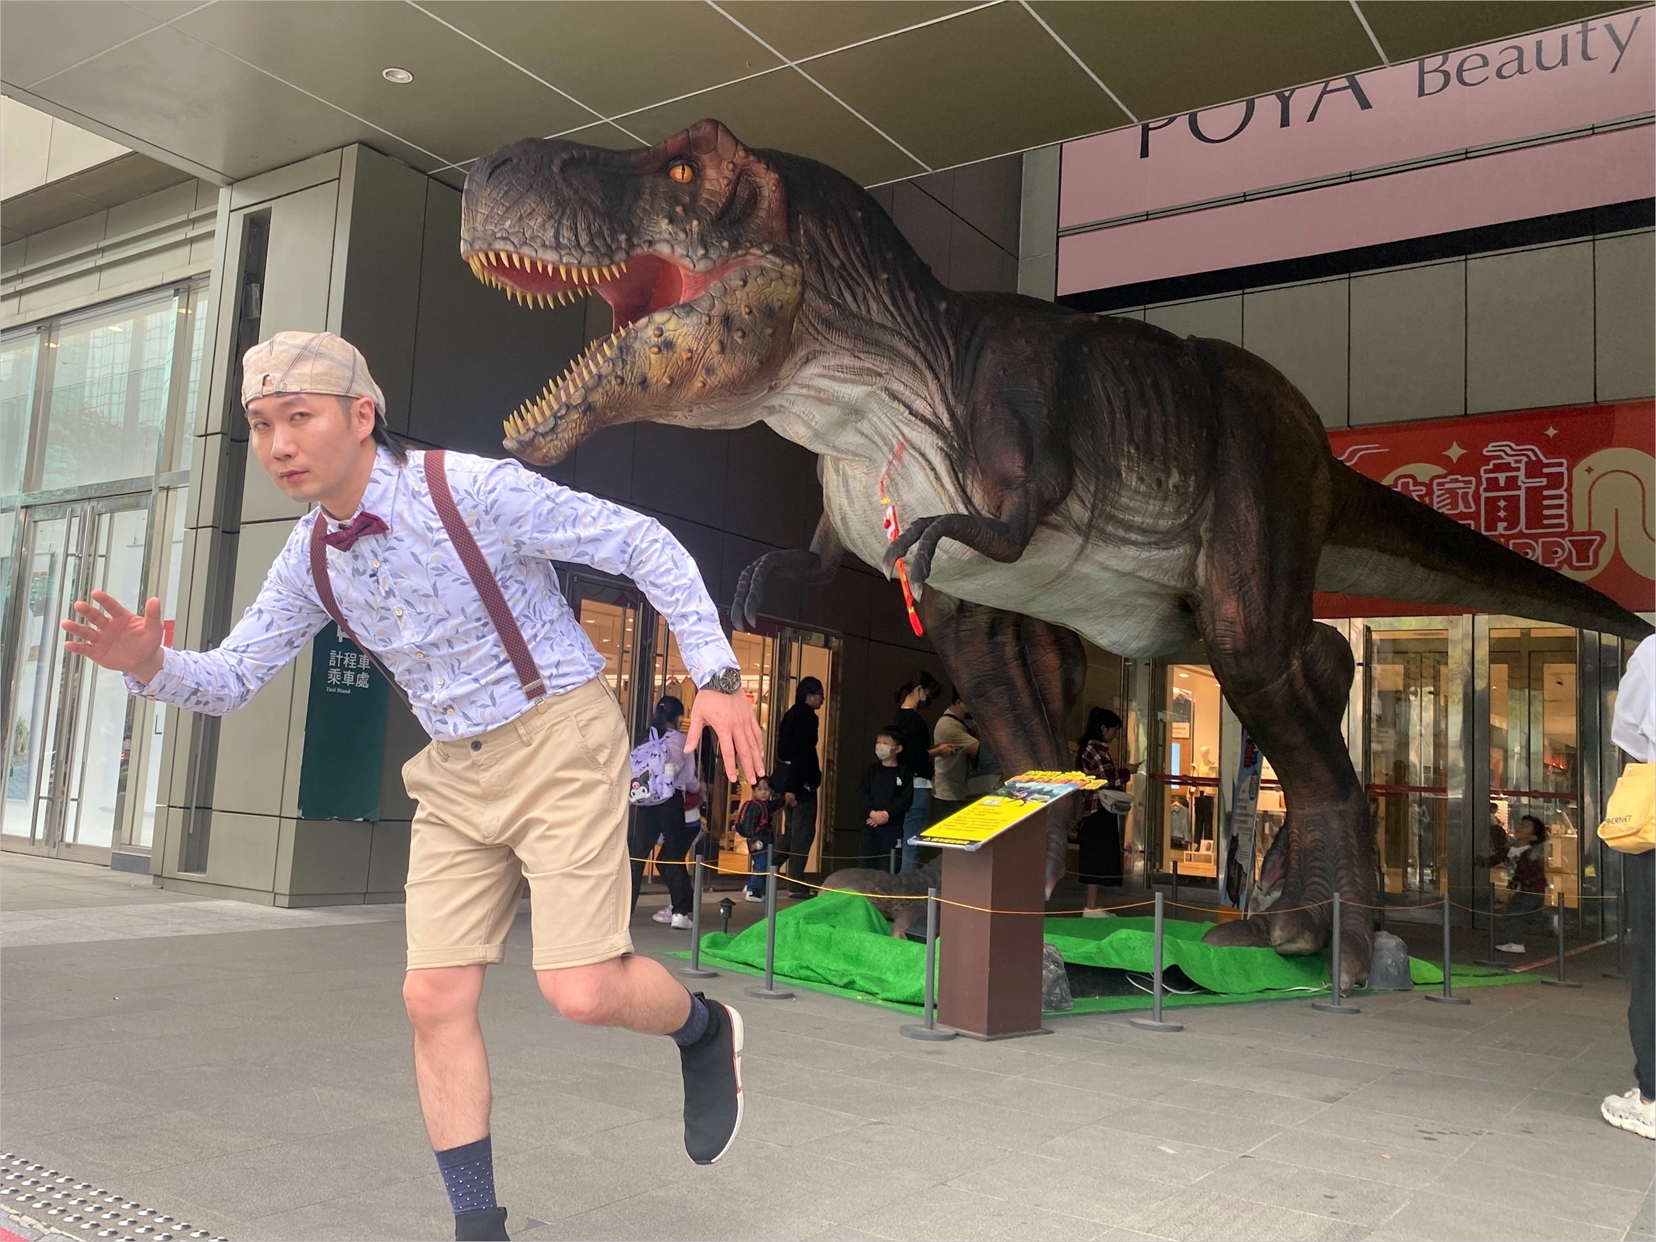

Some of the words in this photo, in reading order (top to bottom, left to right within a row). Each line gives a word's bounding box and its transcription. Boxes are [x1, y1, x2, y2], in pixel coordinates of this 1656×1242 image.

[1417, 15, 1642, 99] Beauty
[1508, 536, 1601, 567] PPY
[329, 650, 371, 670] 計程車
[327, 668, 370, 689] 乘車處
